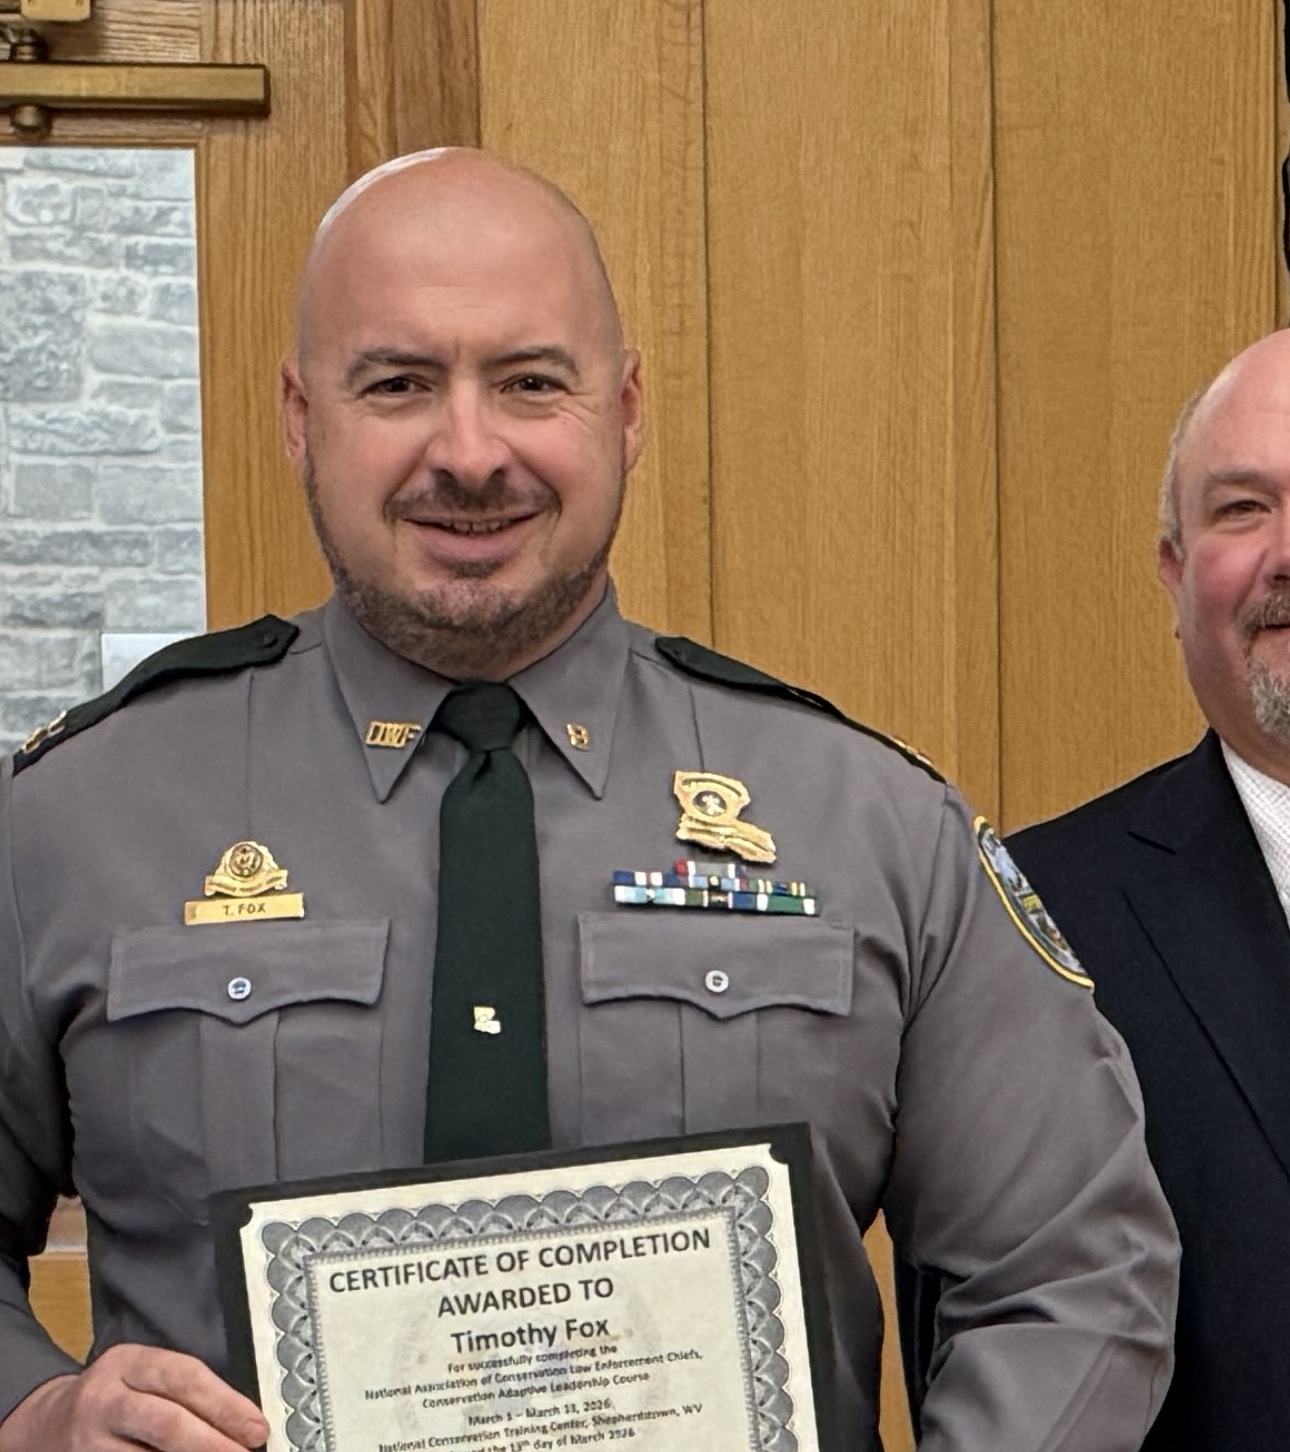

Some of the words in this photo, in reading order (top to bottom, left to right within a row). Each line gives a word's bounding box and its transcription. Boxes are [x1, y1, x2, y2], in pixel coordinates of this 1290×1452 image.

[222, 904, 234, 917] T.
[237, 902, 267, 915] FOX
[329, 1254, 489, 1293] CERTIFICATE
[496, 1249, 530, 1273] OF
[538, 1227, 711, 1268] COMPLETION
[438, 1282, 572, 1318] AWARDED
[578, 1277, 614, 1301] TO
[450, 1322, 558, 1354] Timothy
[565, 1318, 610, 1341] Fox
[364, 1385, 412, 1401] National
[414, 1378, 478, 1394] Association
[480, 1375, 492, 1386] of
[494, 1367, 567, 1385] Conservation
[569, 1365, 592, 1376] Law
[594, 1354, 664, 1372] Enforcement
[666, 1349, 703, 1363] Chiefs,
[447, 1362, 465, 1374] For
[468, 1354, 533, 1372] successfully
[535, 1346, 597, 1363] completing
[599, 1345, 618, 1355] the
[422, 1392, 495, 1409] Conservation
[497, 1384, 548, 1401] Adaptive
[550, 1375, 610, 1393] Leadership
[612, 1371, 650, 1386] Course
[428, 1429, 501, 1448] Conservation
[503, 1424, 549, 1438] Training
[549, 1419, 589, 1432] Center,
[682, 1403, 703, 1416] WV
[467, 1411, 503, 1427] March
[525, 1405, 561, 1418] March
[533, 1439, 553, 1450] day
[556, 1434, 567, 1447] of
[570, 1431, 605, 1445] March
